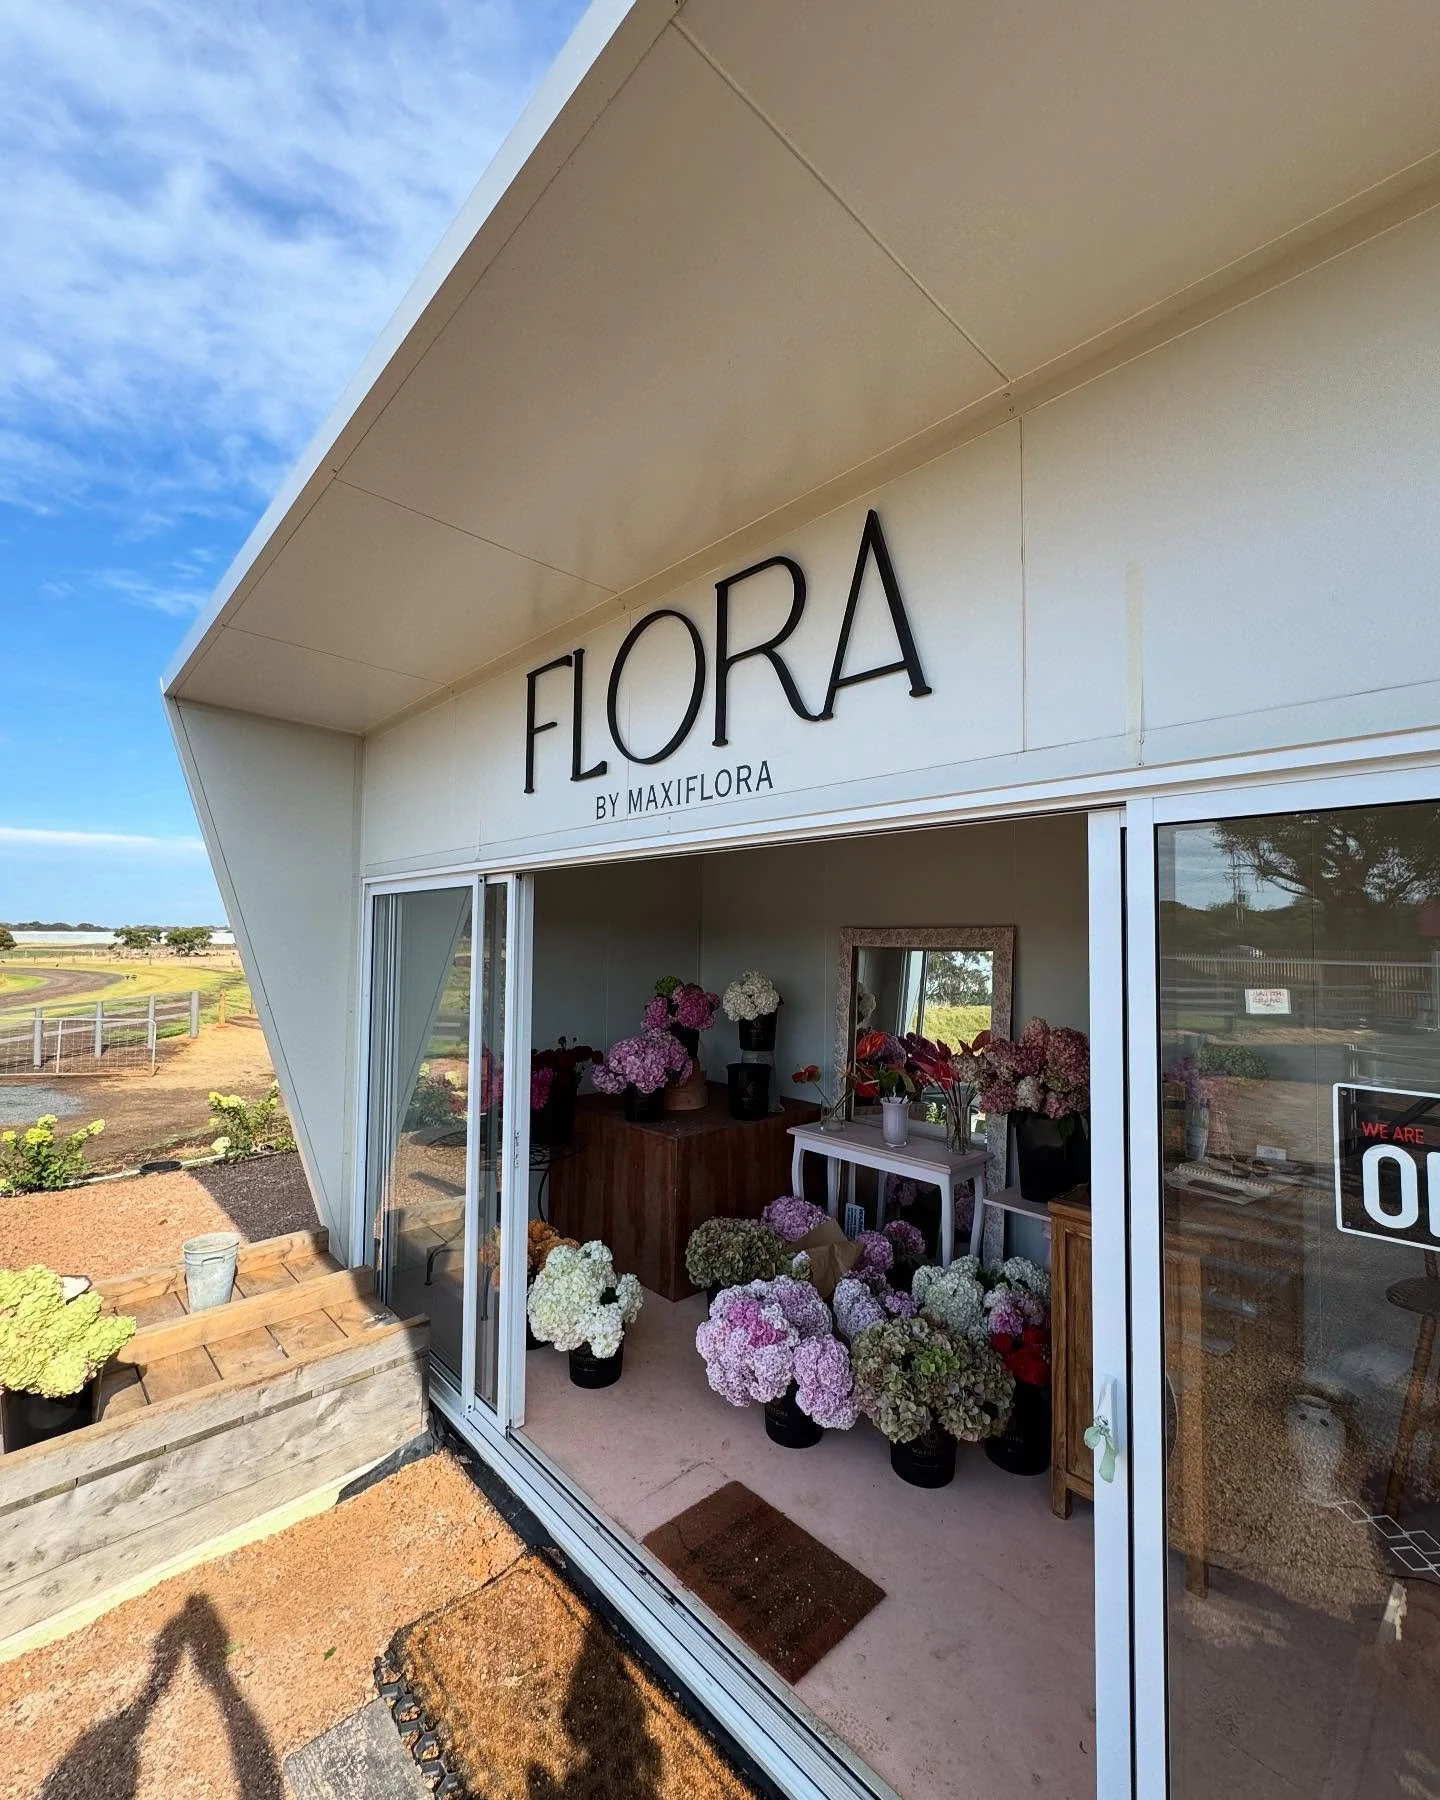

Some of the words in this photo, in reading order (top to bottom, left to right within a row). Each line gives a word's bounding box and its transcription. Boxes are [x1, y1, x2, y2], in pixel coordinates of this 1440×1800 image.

[523, 509, 932, 794] FLORA
[595, 792, 619, 820] BY
[628, 760, 774, 814] MAXIFLORA
[1361, 1121, 1389, 1140] WE
[1392, 1126, 1425, 1145] ARE
[1362, 1144, 1440, 1238] O
